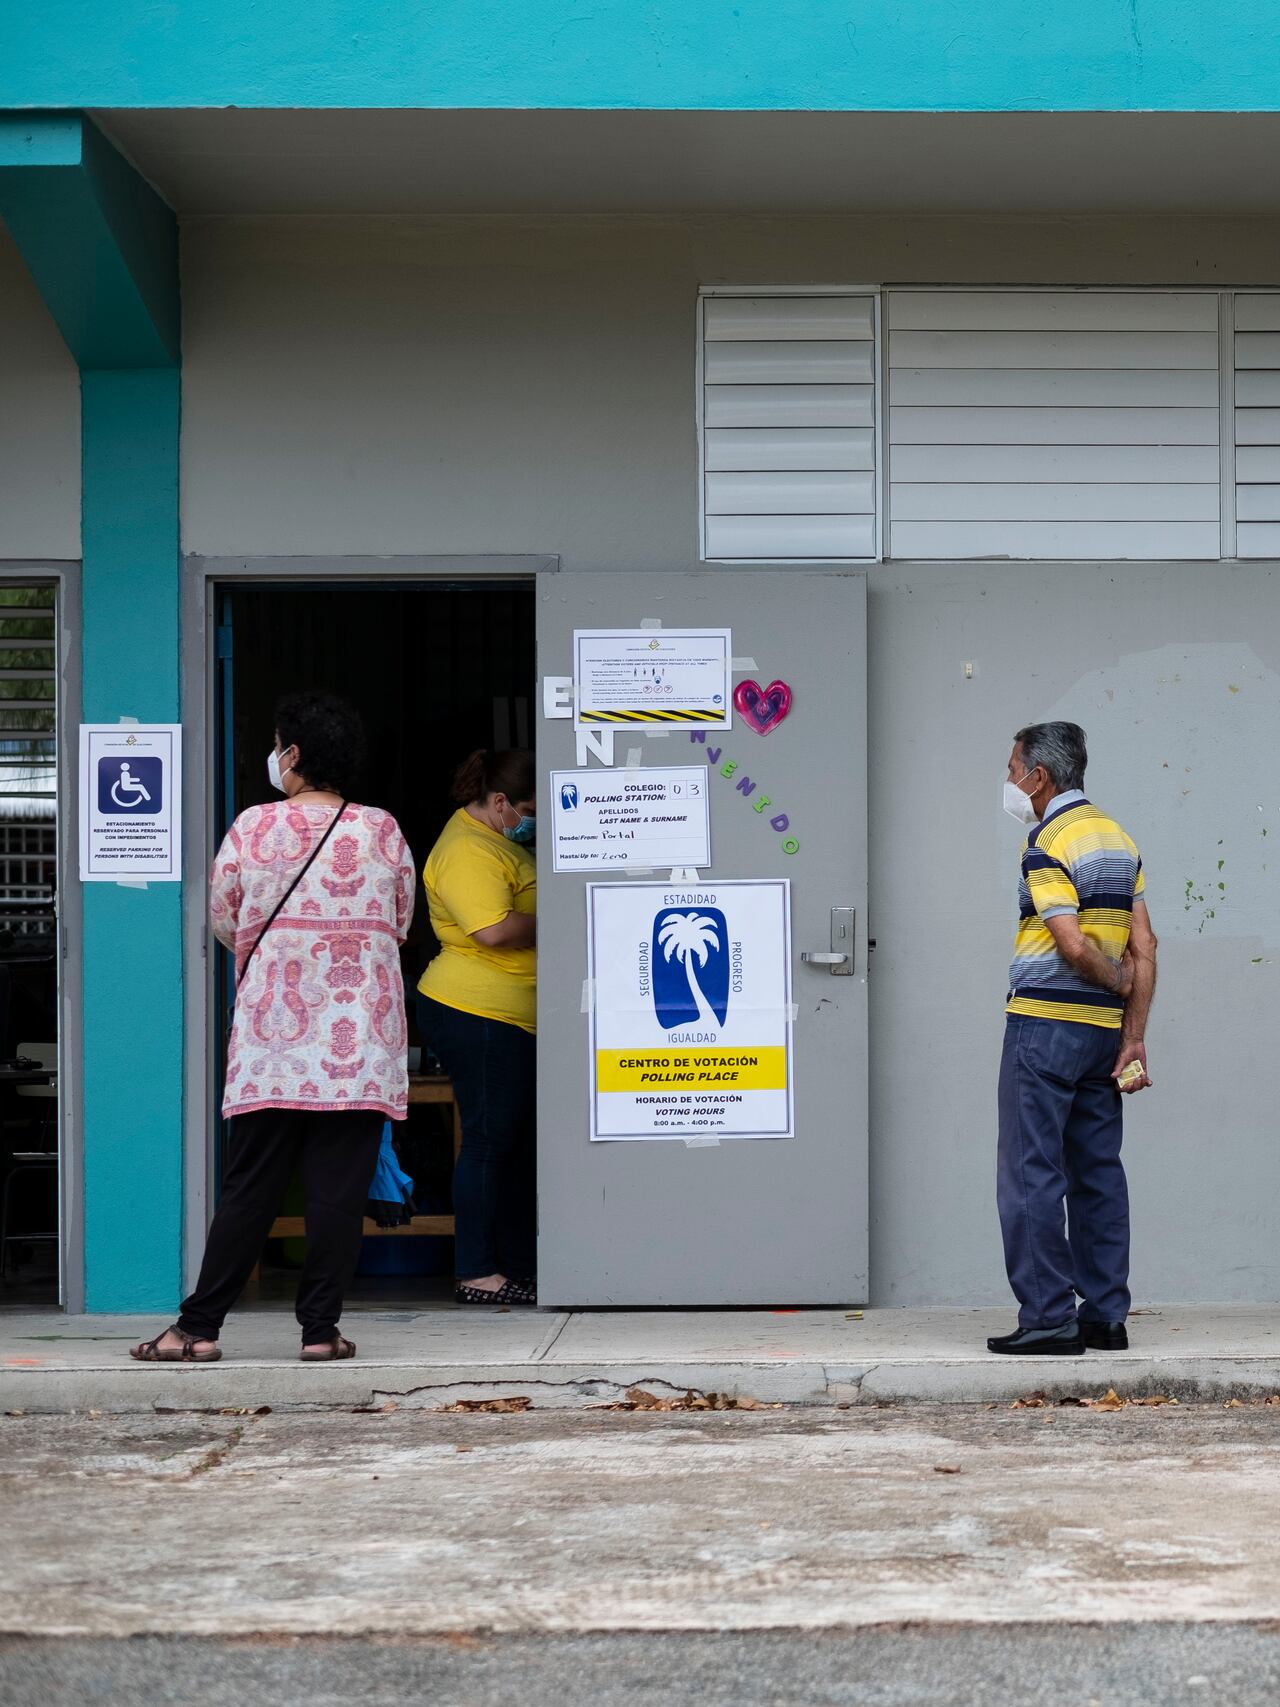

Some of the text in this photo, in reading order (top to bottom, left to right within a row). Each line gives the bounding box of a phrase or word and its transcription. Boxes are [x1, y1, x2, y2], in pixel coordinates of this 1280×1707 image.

[624, 784, 666, 792] COLEGIO:
[624, 794, 667, 802] STATION:
[650, 815, 688, 823] SURNAME
[663, 894, 717, 905] ESTADIDAD
[639, 941, 650, 997] SEGURIDAD
[731, 941, 743, 993] PROGRESO
[668, 1033, 717, 1043] IGUALDAD
[619, 1056, 758, 1068] CENTRO DE VOTACIÓN
[640, 1072, 739, 1082] POLLING PLACE
[694, 1094, 743, 1103] VOTACIÓN
